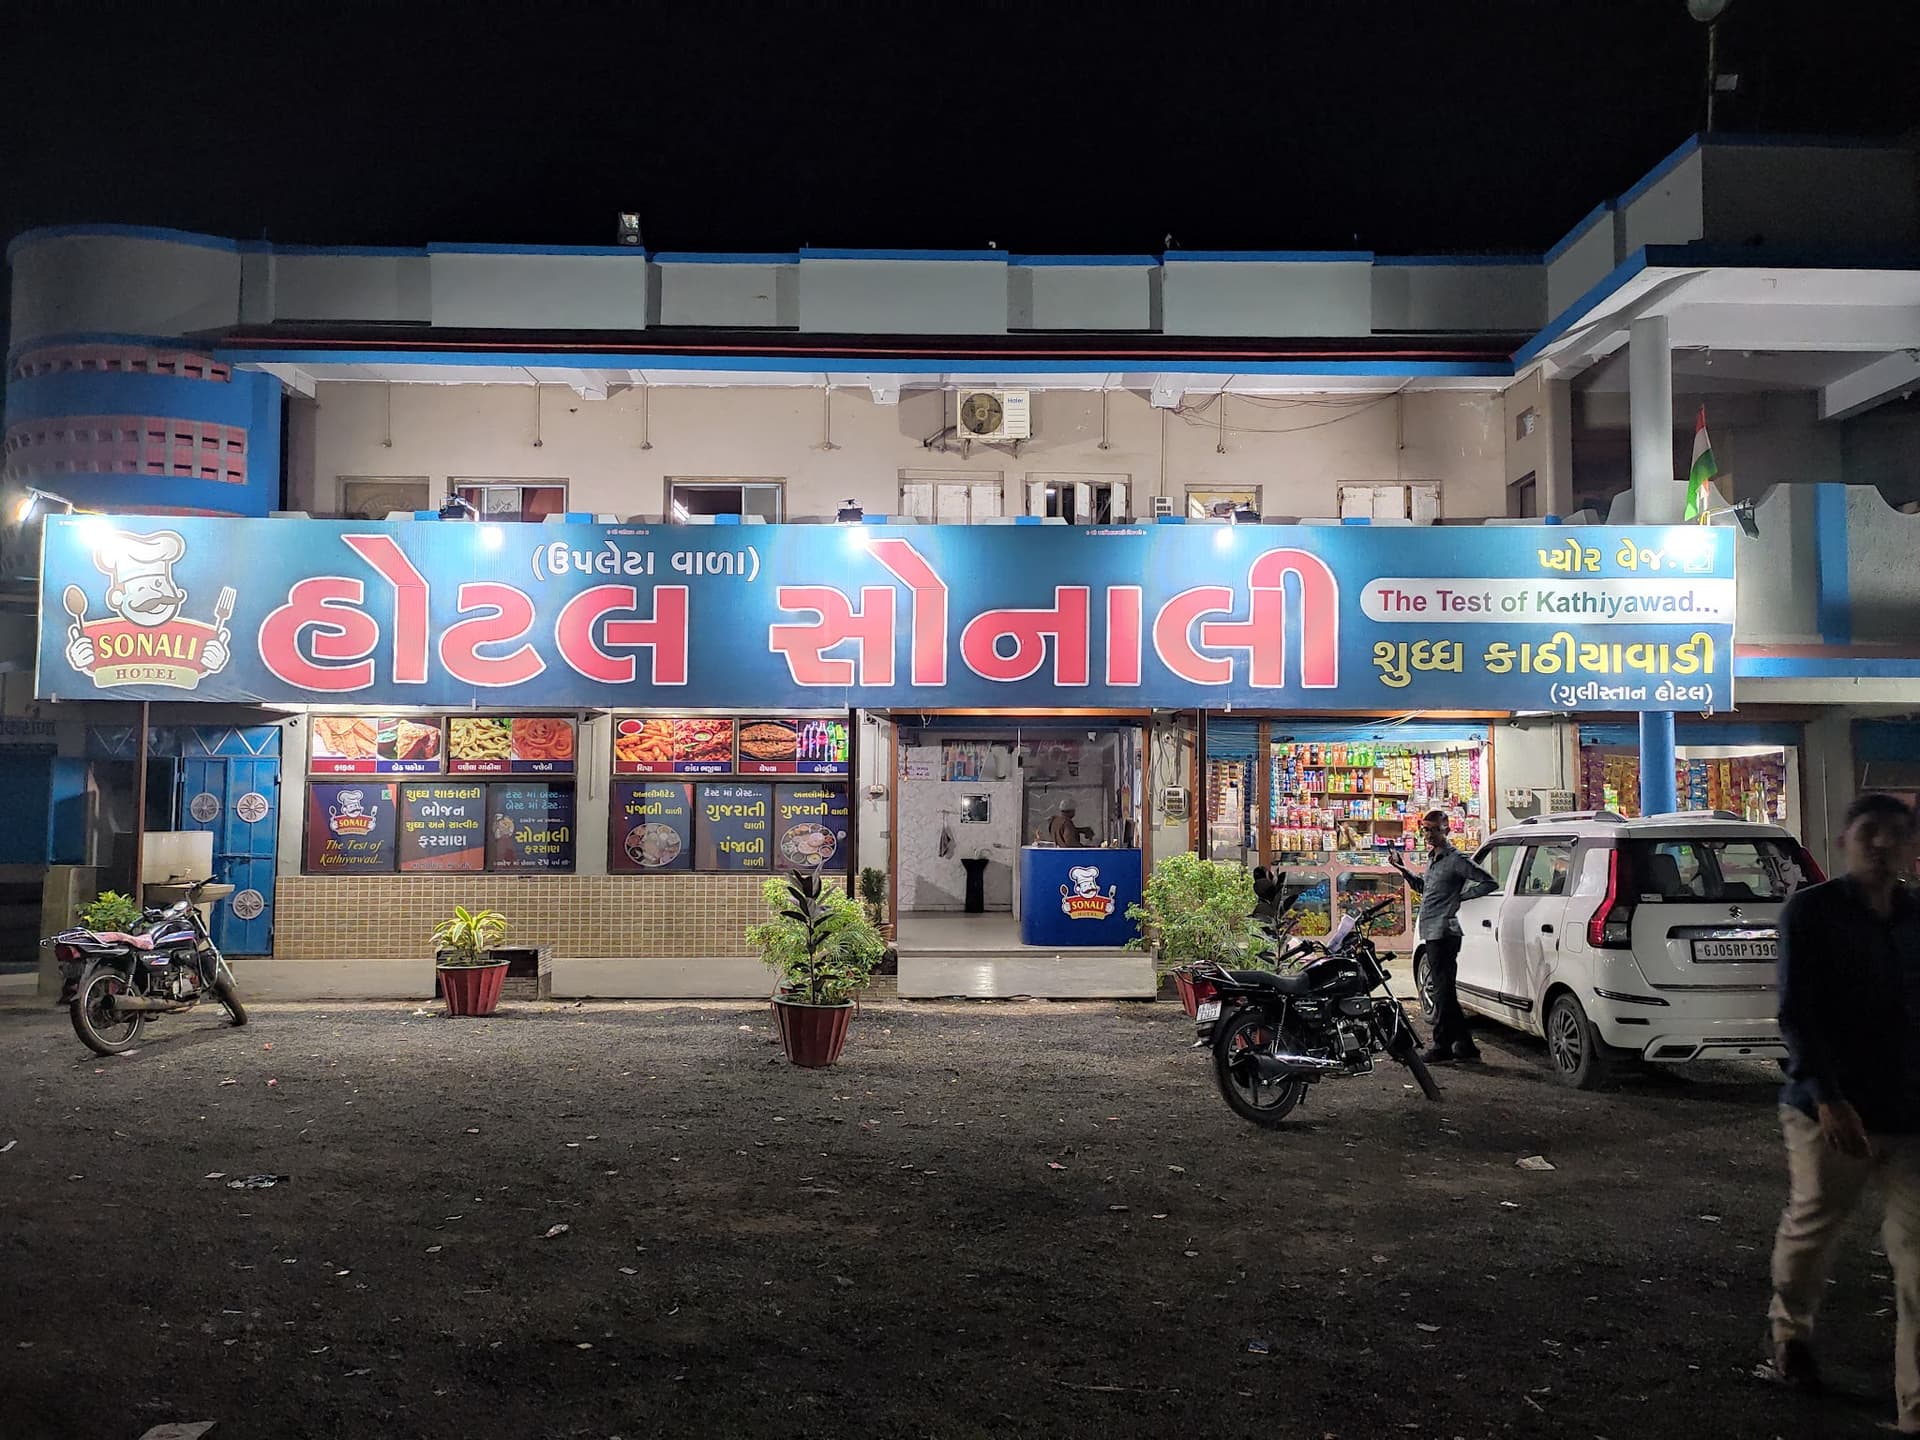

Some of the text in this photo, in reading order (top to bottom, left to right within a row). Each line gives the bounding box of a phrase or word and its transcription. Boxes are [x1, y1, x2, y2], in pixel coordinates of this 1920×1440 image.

[531, 540, 761, 582] (ઉપલેટા વાળા)
[1537, 538, 1601, 573] પ્યોર
[1377, 590, 1719, 619] The Test of Kathiyawad...
[257, 533, 1339, 693] હોટલ સોનાલી
[98, 632, 198, 661] SONALI
[1484, 631, 1715, 676] કાઠીયાવાડી
[115, 668, 177, 681] HOTEL
[1549, 680, 1714, 705] (ગુલીસ્તાન હોટલ)
[434, 787, 481, 799] શાકાહારી
[421, 801, 465, 816] ભોજન
[625, 800, 662, 815] પંજાબી
[706, 801, 765, 822] ગુજરાતી
[781, 802, 828, 819] ગુજરાતી
[338, 819, 367, 827] SONALI
[428, 819, 445, 829] અને
[743, 820, 765, 830] થાળી
[418, 835, 467, 848] ફરસાણ
[515, 826, 570, 843] સોનાલી
[326, 840, 384, 853] The Test of
[524, 845, 560, 855] ફરસાણ
[720, 835, 765, 853] પંજાબી
[743, 857, 764, 866] થાળી
[1071, 901, 1104, 910] SONALI
